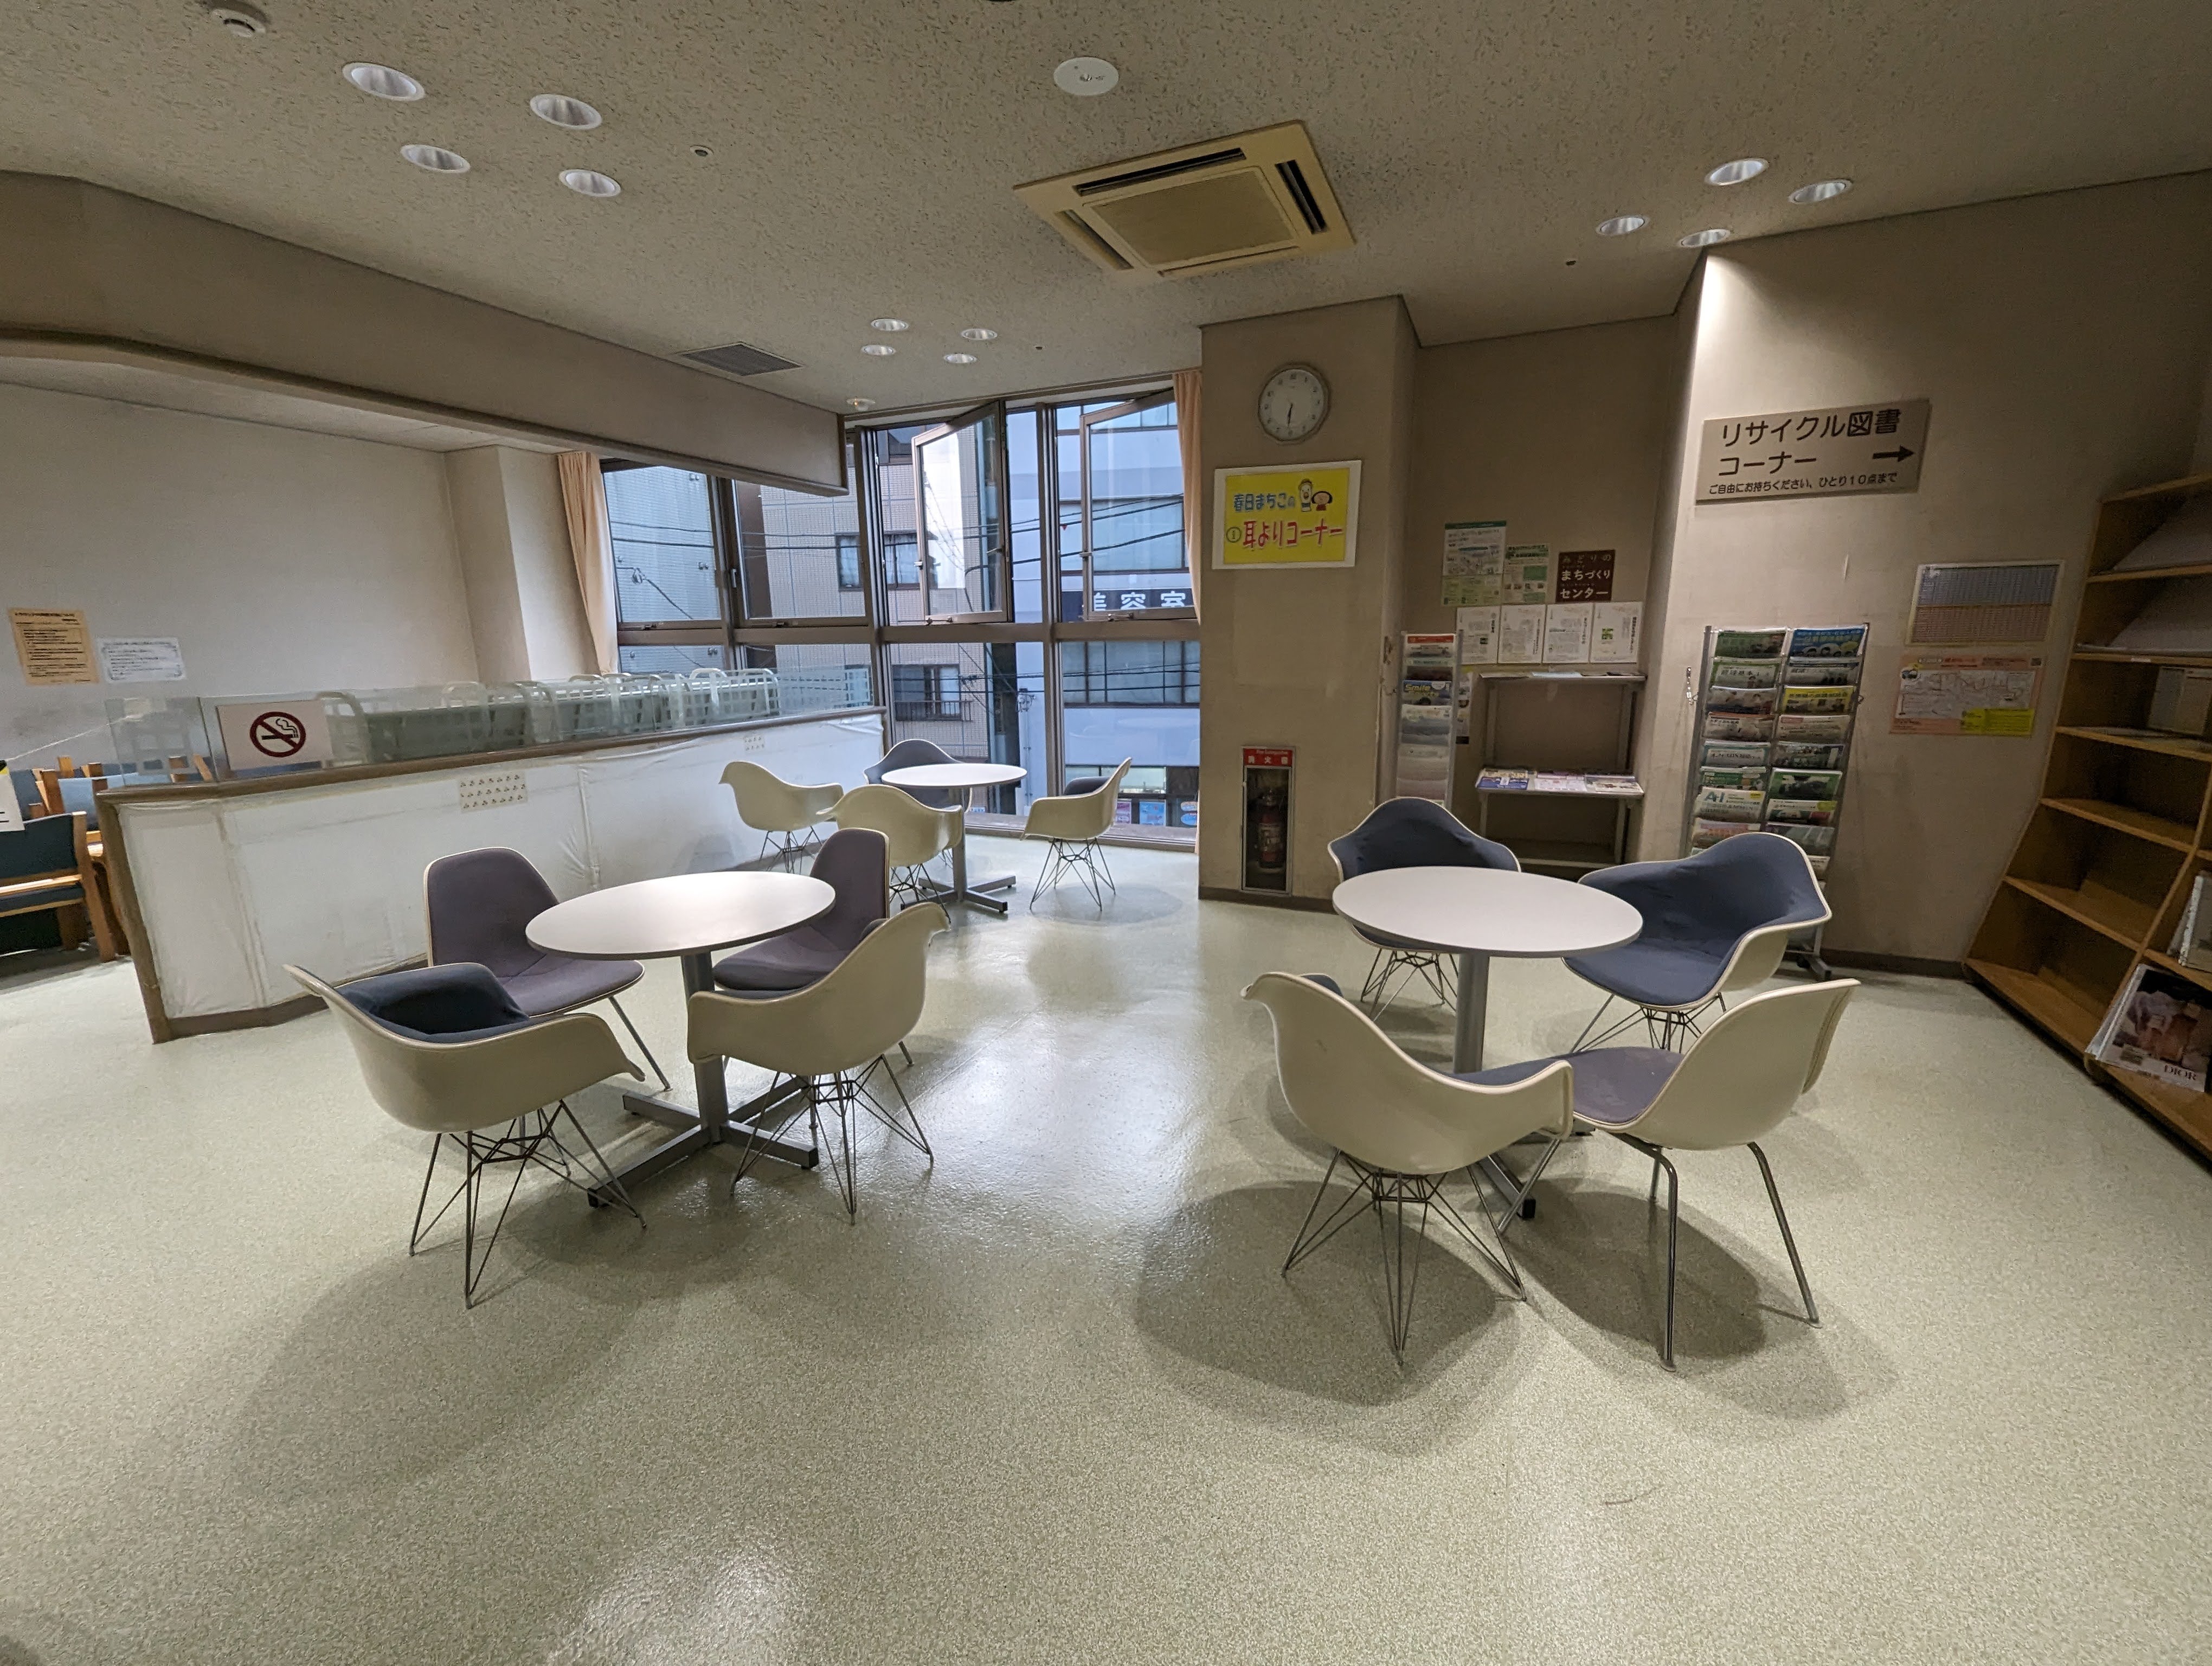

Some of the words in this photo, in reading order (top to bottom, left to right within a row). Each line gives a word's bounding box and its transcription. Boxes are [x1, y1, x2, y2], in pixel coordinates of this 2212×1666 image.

[1722, 408, 1901, 447] リサイクル図書
[1719, 451, 1817, 476] コーナー
[1243, 518, 1342, 548] 耳よりコーナー
[1561, 569, 1610, 581] まちづくり
[1560, 587, 1609, 599] センター
